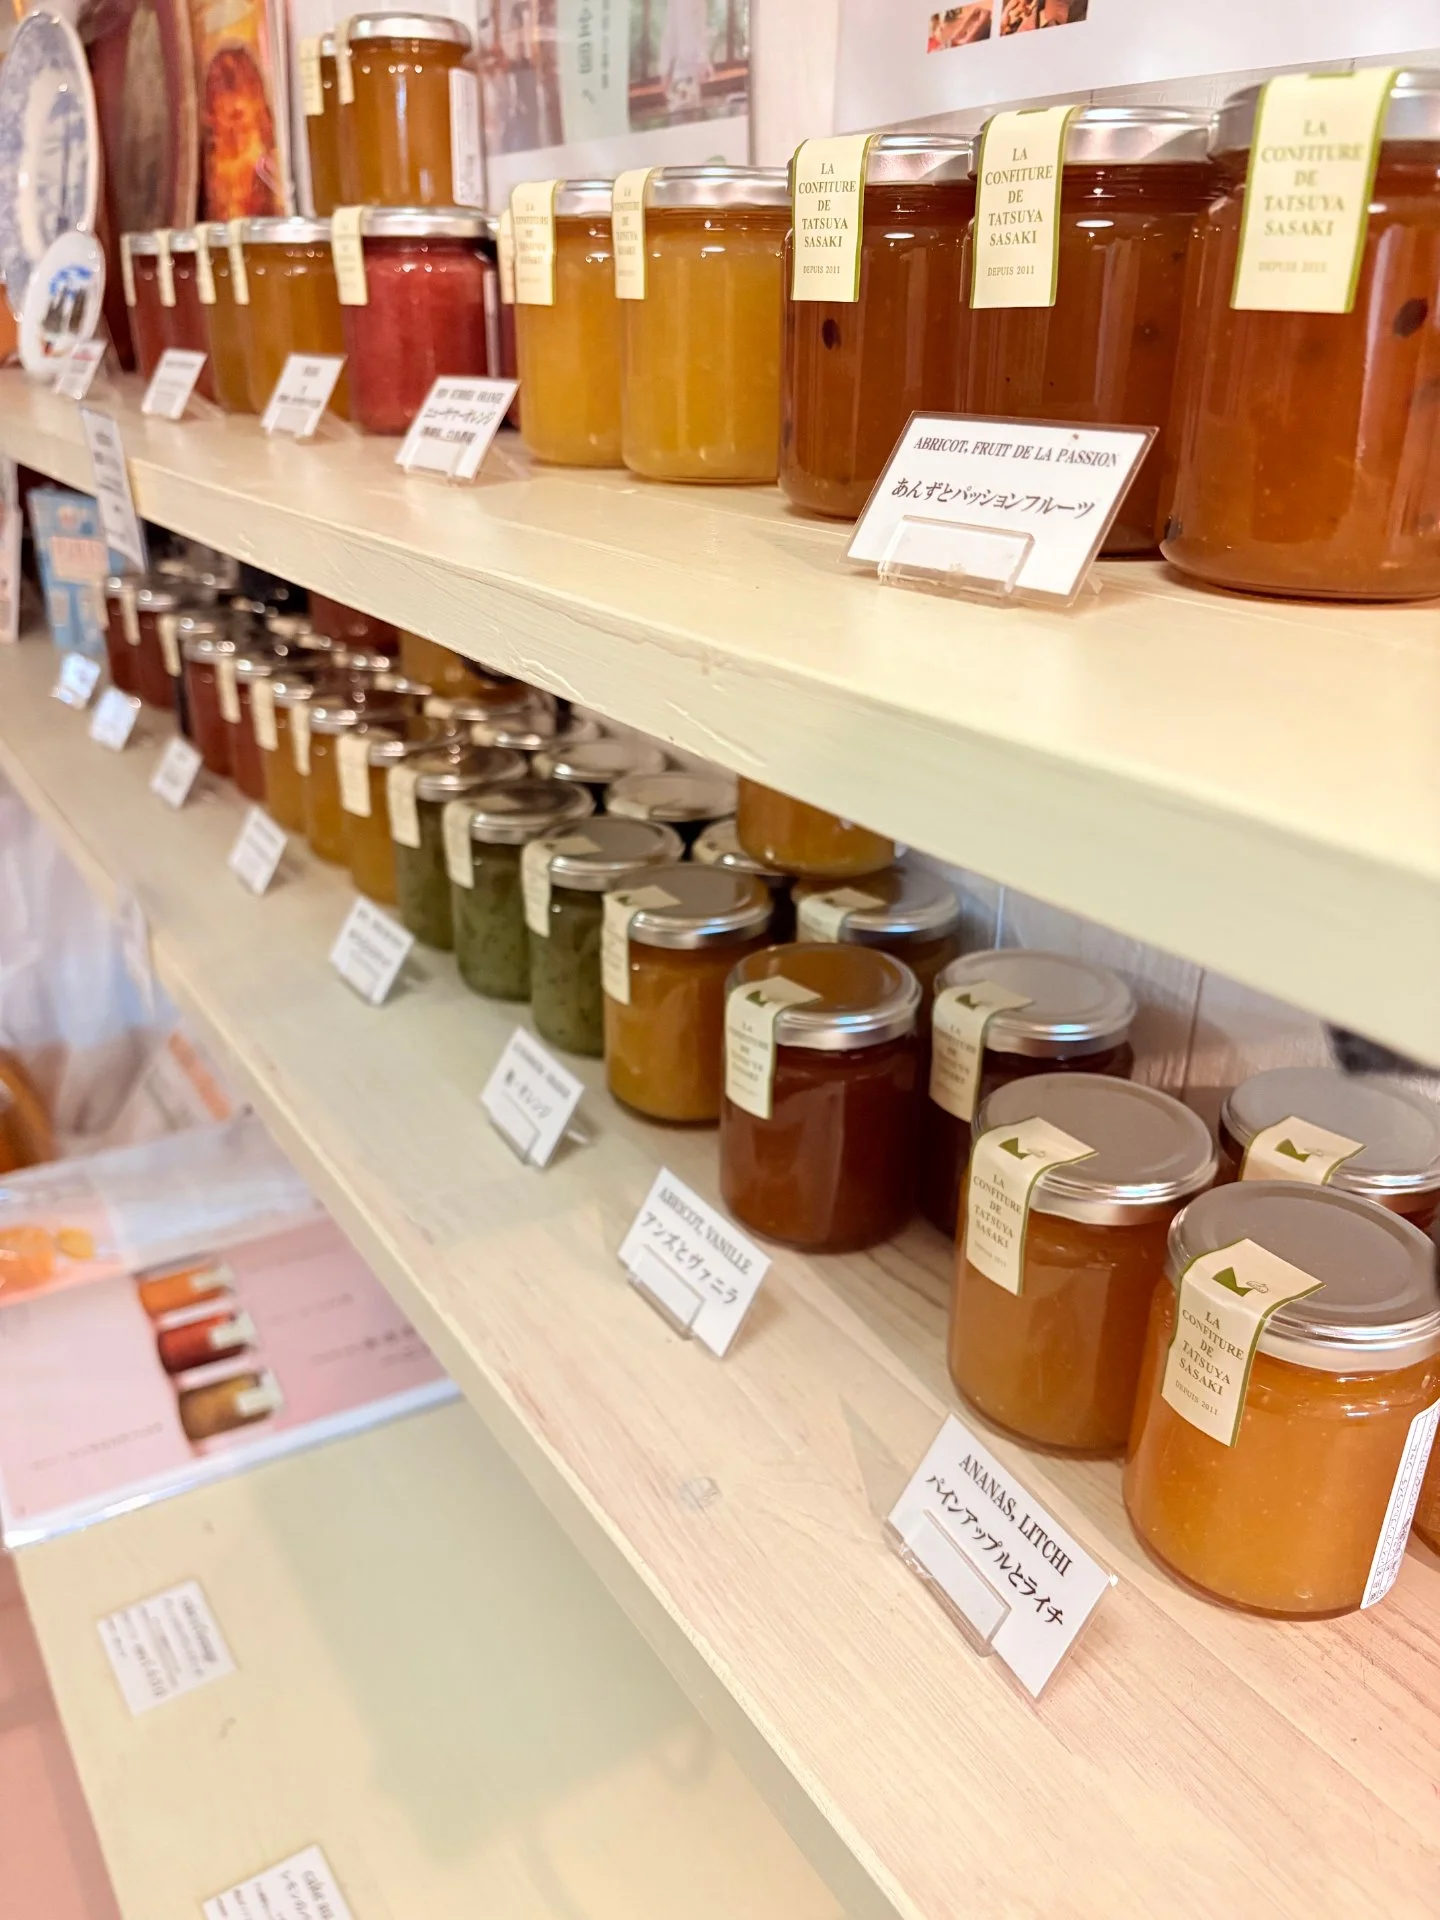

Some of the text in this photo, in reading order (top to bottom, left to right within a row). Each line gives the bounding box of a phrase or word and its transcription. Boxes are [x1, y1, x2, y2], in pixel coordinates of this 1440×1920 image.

[1303, 119, 1328, 137] LA
[1012, 147, 1028, 162] LA
[1260, 143, 1366, 163] CONFITURE
[820, 163, 834, 175] LA
[985, 165, 1053, 186] CONFITURE
[1294, 169, 1318, 187] DE
[798, 180, 857, 194] CONFITURE
[817, 199, 831, 211] DE
[1007, 189, 1024, 204] DE
[1264, 195, 1345, 213] TATSUYA
[802, 217, 848, 230] TATSUYA
[988, 208, 1043, 226] TATSUYA
[1264, 219, 1334, 237] SASAKI
[804, 235, 843, 248] SASAKI
[989, 230, 1037, 246] SASAKI
[803, 265, 840, 274] DEPUIS 2011
[987, 265, 1035, 277] DEPUIS 2011
[913, 436, 1121, 468] ABRICOT, FRUIT DE LA PASSION
[891, 477, 1096, 519] あんずとパッションフルーツ
[992, 1173, 1005, 1190] LA
[973, 1175, 1022, 1215] CONFITURE
[989, 1200, 1002, 1216] DE
[974, 1204, 1014, 1239] TATSUYA
[975, 1219, 1010, 1250] SASAKI
[641, 1210, 740, 1305] アンズとヴァニラ
[705, 1225, 754, 1276] VANILLE
[1204, 1311, 1221, 1330] LA
[1182, 1308, 1245, 1361] CONFITURE
[1199, 1339, 1214, 1358] DE
[1182, 1339, 1231, 1385] TATSUYA
[1179, 1357, 1224, 1396] SASAKI
[1175, 1380, 1218, 1416] DEPUIS 2011
[958, 1453, 1073, 1578] ANANAS, LITCHI
[925, 1473, 1064, 1626] パインアップルとライチ
